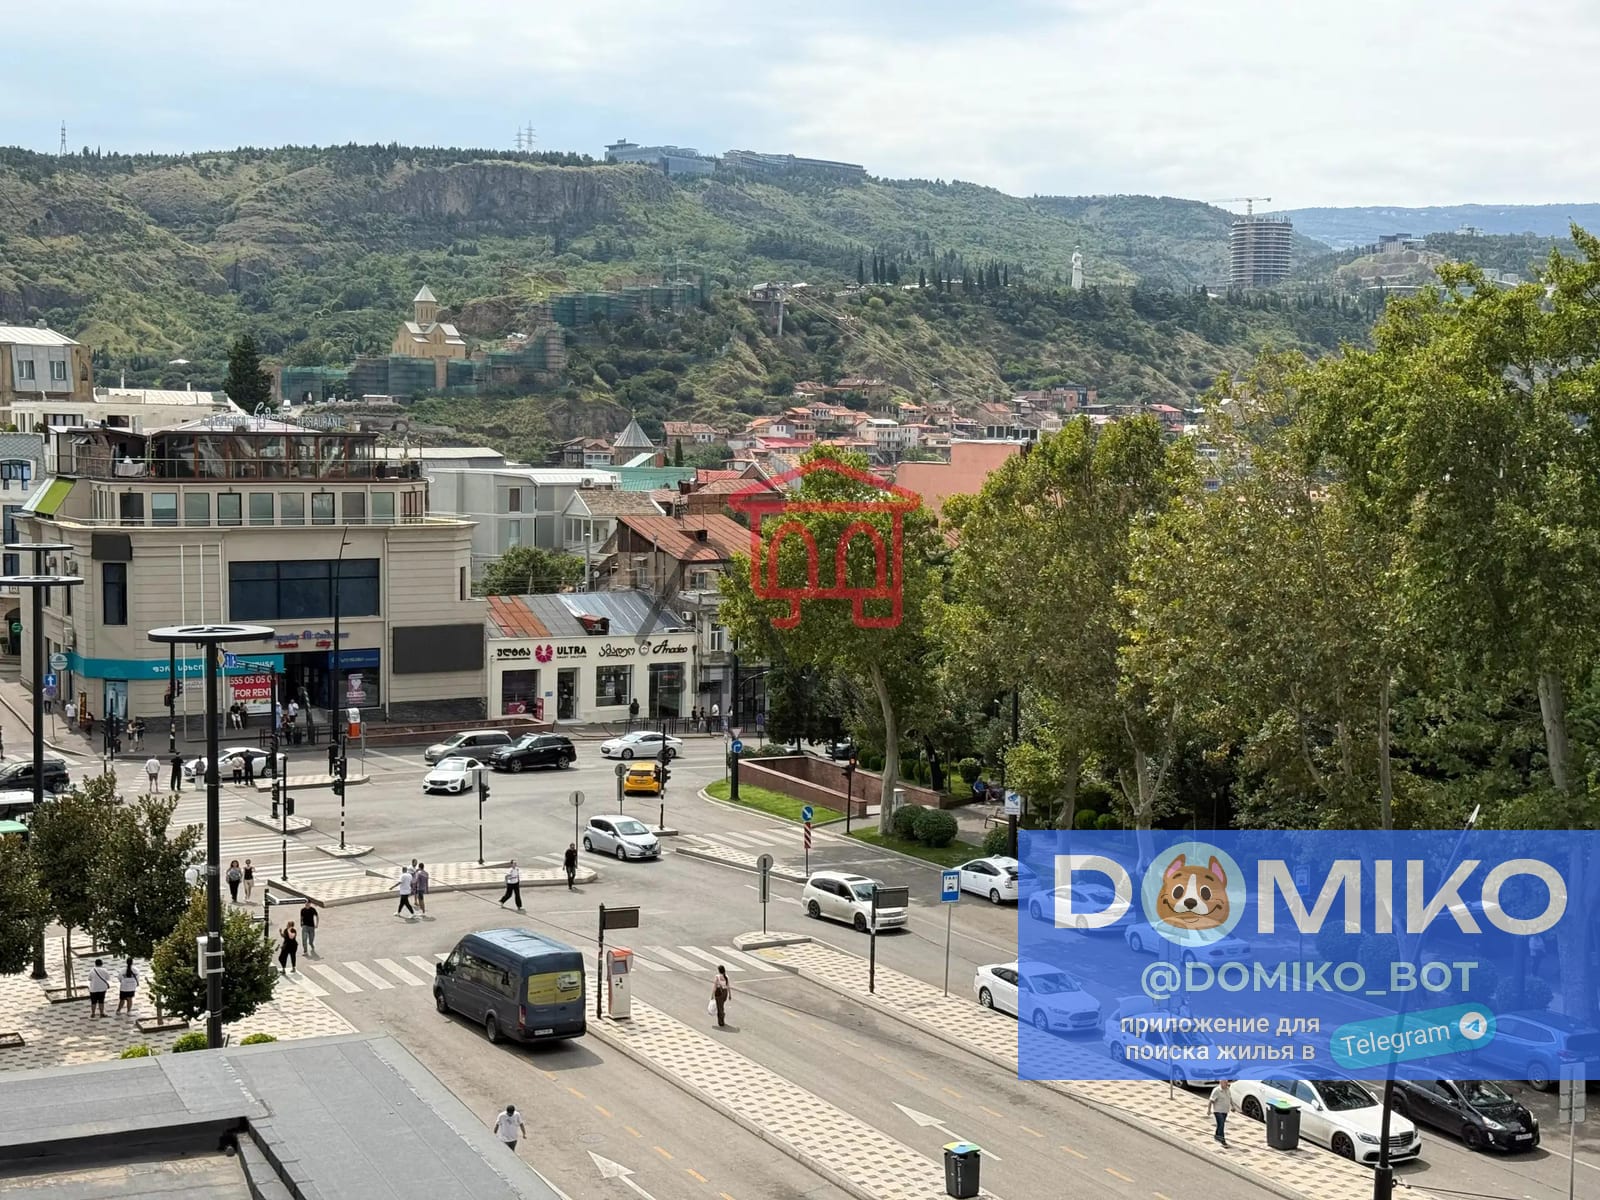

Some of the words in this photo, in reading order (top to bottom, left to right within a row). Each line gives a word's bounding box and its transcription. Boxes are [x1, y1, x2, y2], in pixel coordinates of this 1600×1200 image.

[557, 646, 587, 654] ULTRA
[244, 676, 255, 684] 05
[256, 675, 265, 683] 05
[235, 689, 251, 698] FOR
[252, 688, 272, 697] RENT
